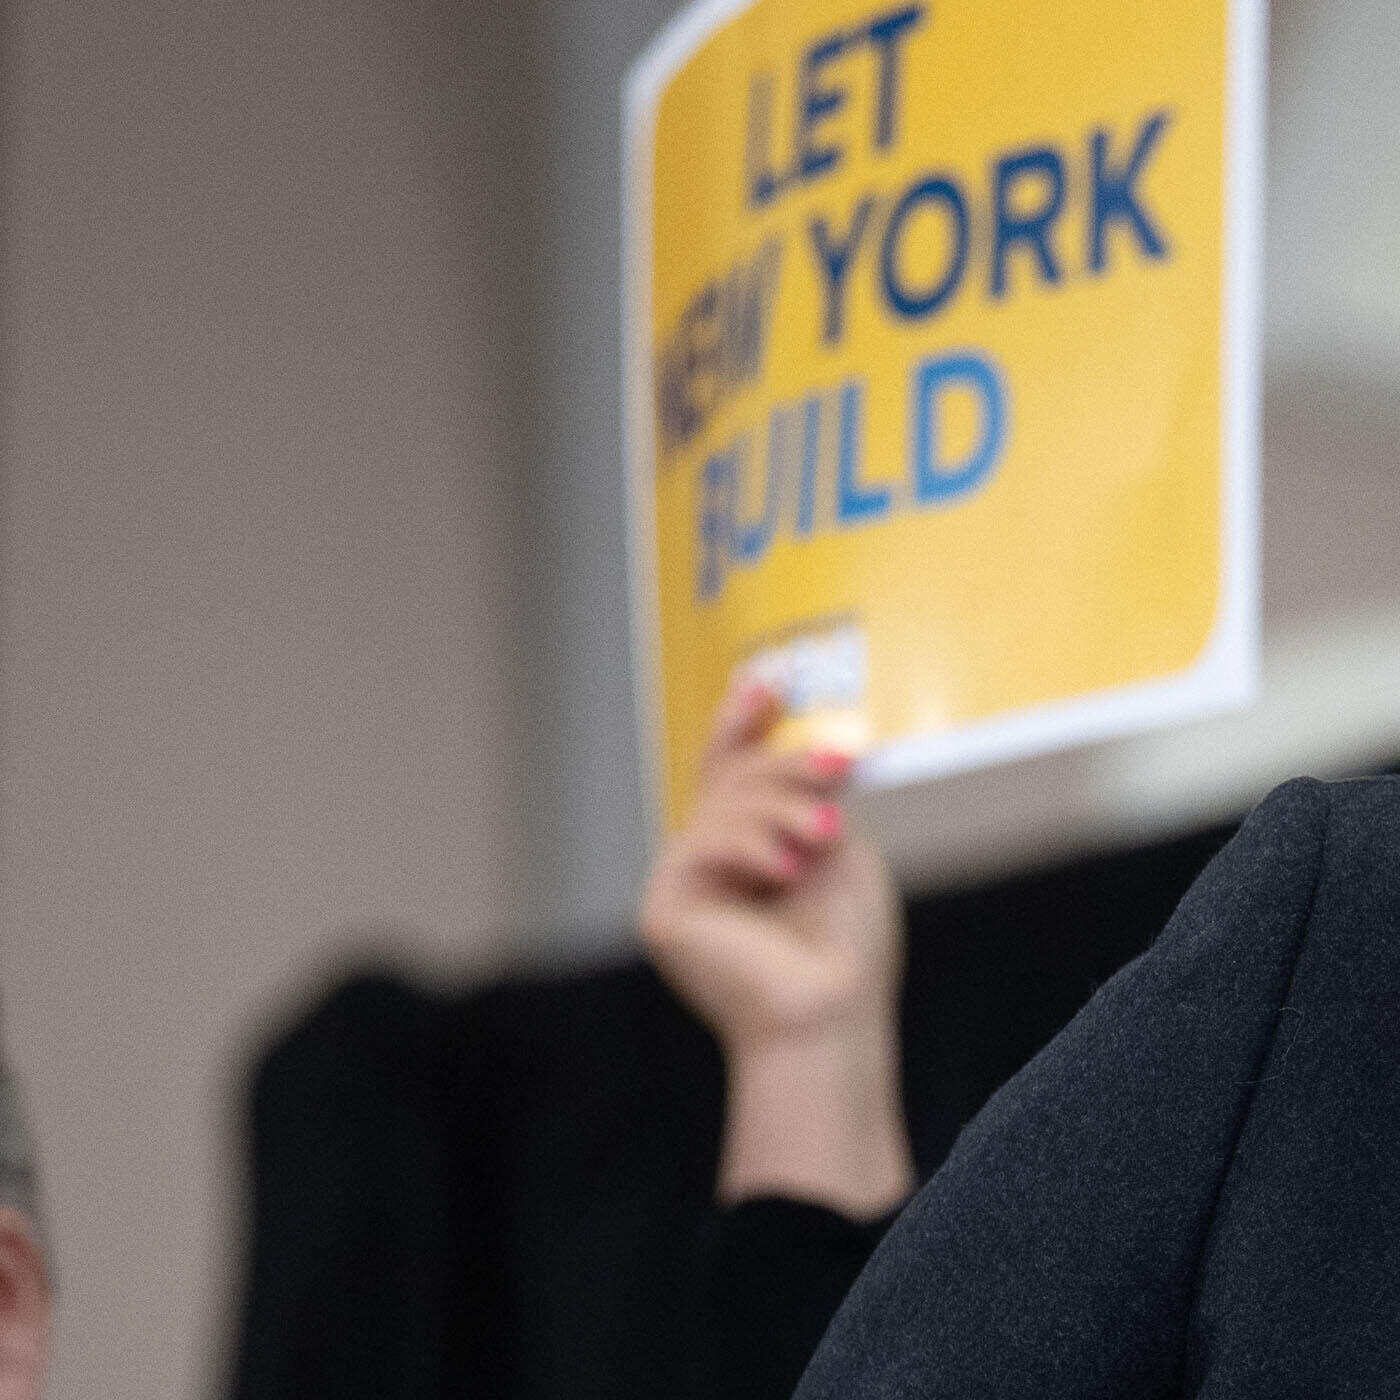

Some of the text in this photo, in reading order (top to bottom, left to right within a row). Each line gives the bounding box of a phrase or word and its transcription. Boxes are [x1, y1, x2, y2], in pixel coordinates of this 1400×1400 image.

[743, 3, 926, 211] LET
[808, 106, 1173, 347] YORK
[696, 349, 1008, 603] BUILD
